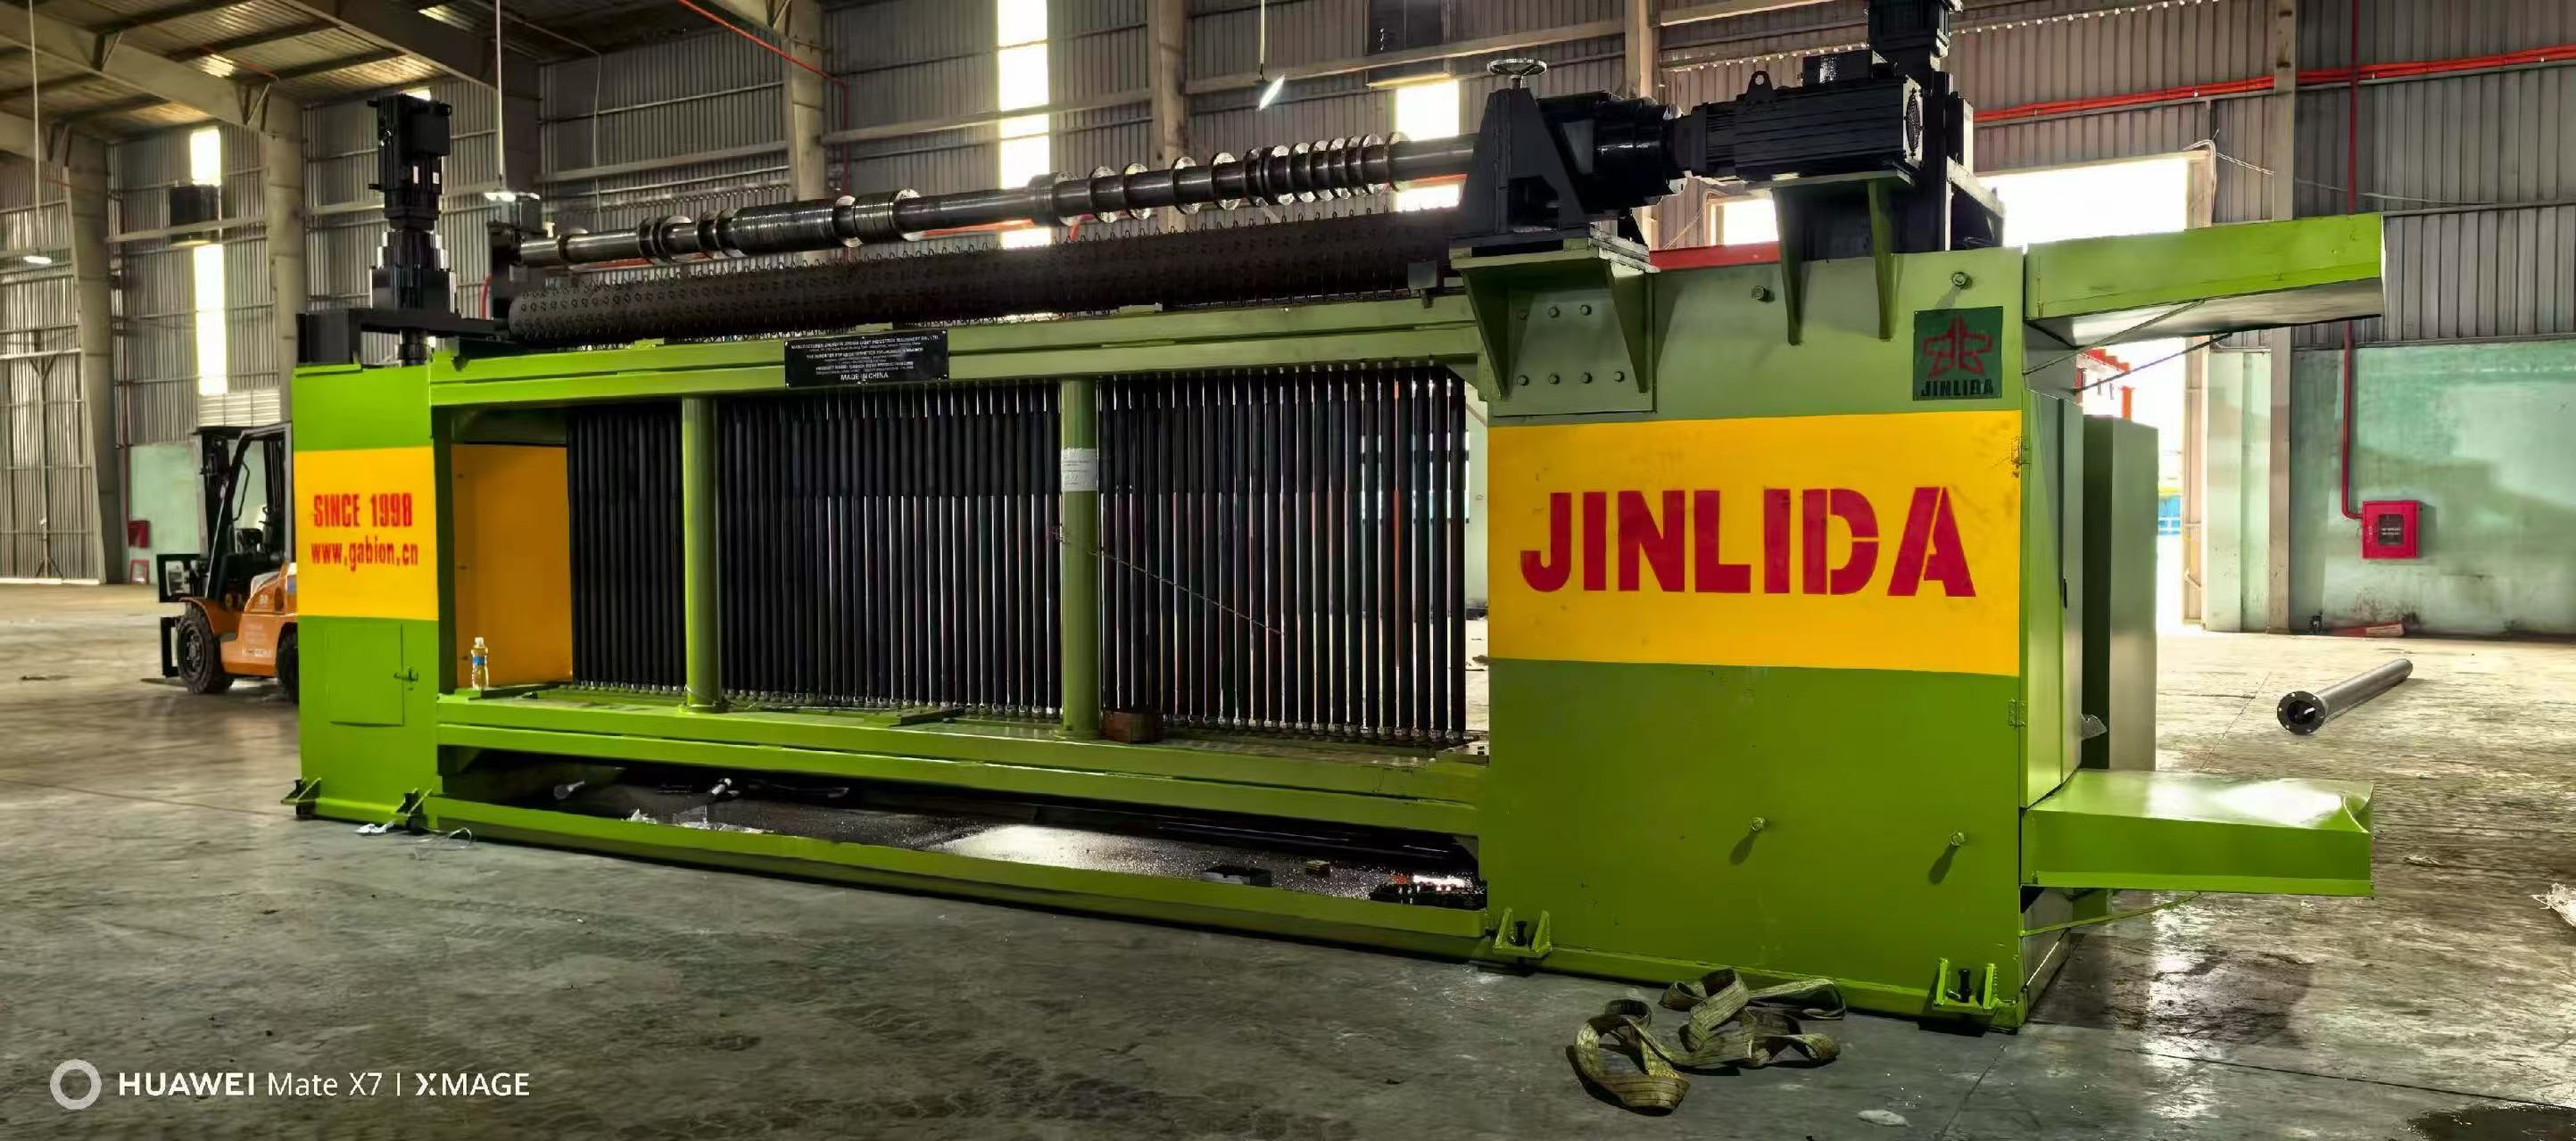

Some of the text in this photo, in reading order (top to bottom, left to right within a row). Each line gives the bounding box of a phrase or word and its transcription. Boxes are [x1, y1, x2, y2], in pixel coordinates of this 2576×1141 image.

[841, 373, 859, 381] MADE
[314, 492, 412, 527] SINCE 1998
[311, 535, 418, 572] www.gabion.cn
[1520, 486, 1976, 597] JINLIDA
